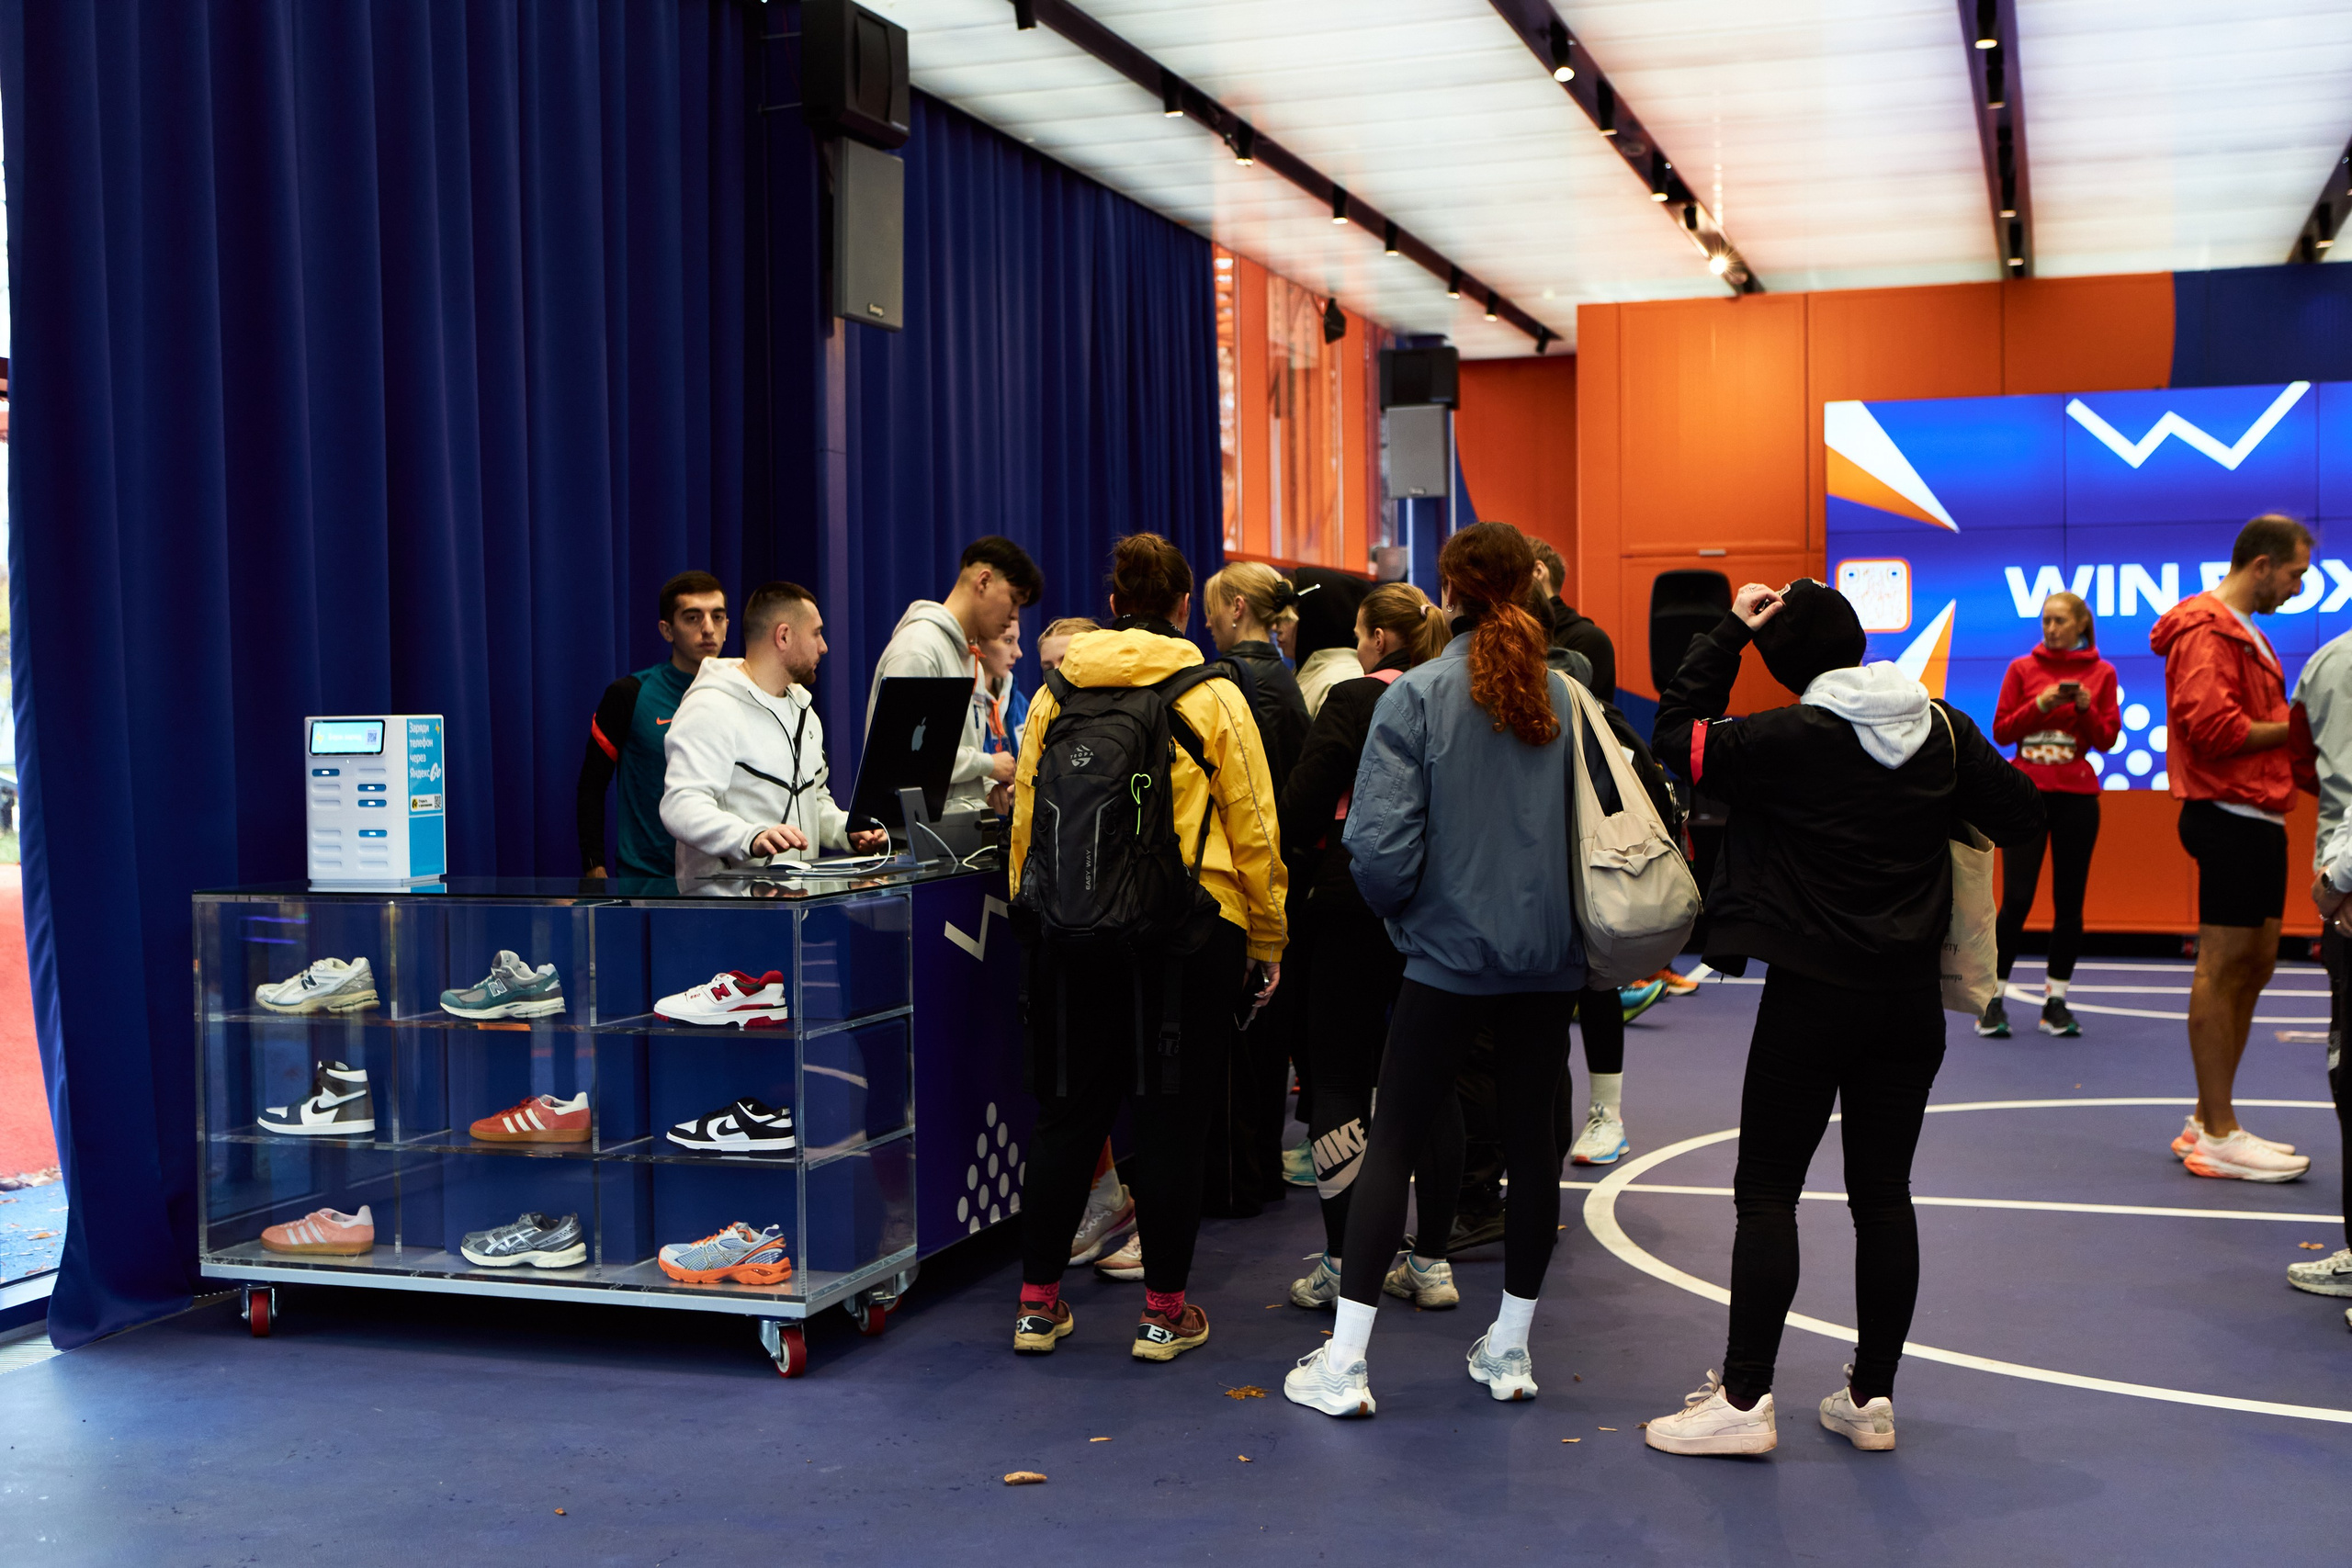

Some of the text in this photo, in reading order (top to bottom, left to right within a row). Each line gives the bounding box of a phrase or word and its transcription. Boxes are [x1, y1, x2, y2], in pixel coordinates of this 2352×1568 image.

[2005, 562, 2179, 618] WIN
[409, 722, 429, 734] Заряди
[410, 737, 434, 749] телефон
[410, 753, 426, 763] через
[1070, 751, 1094, 760] TROPA
[410, 761, 442, 782] Яндекс Go
[1311, 1117, 1367, 1177] NIKE
